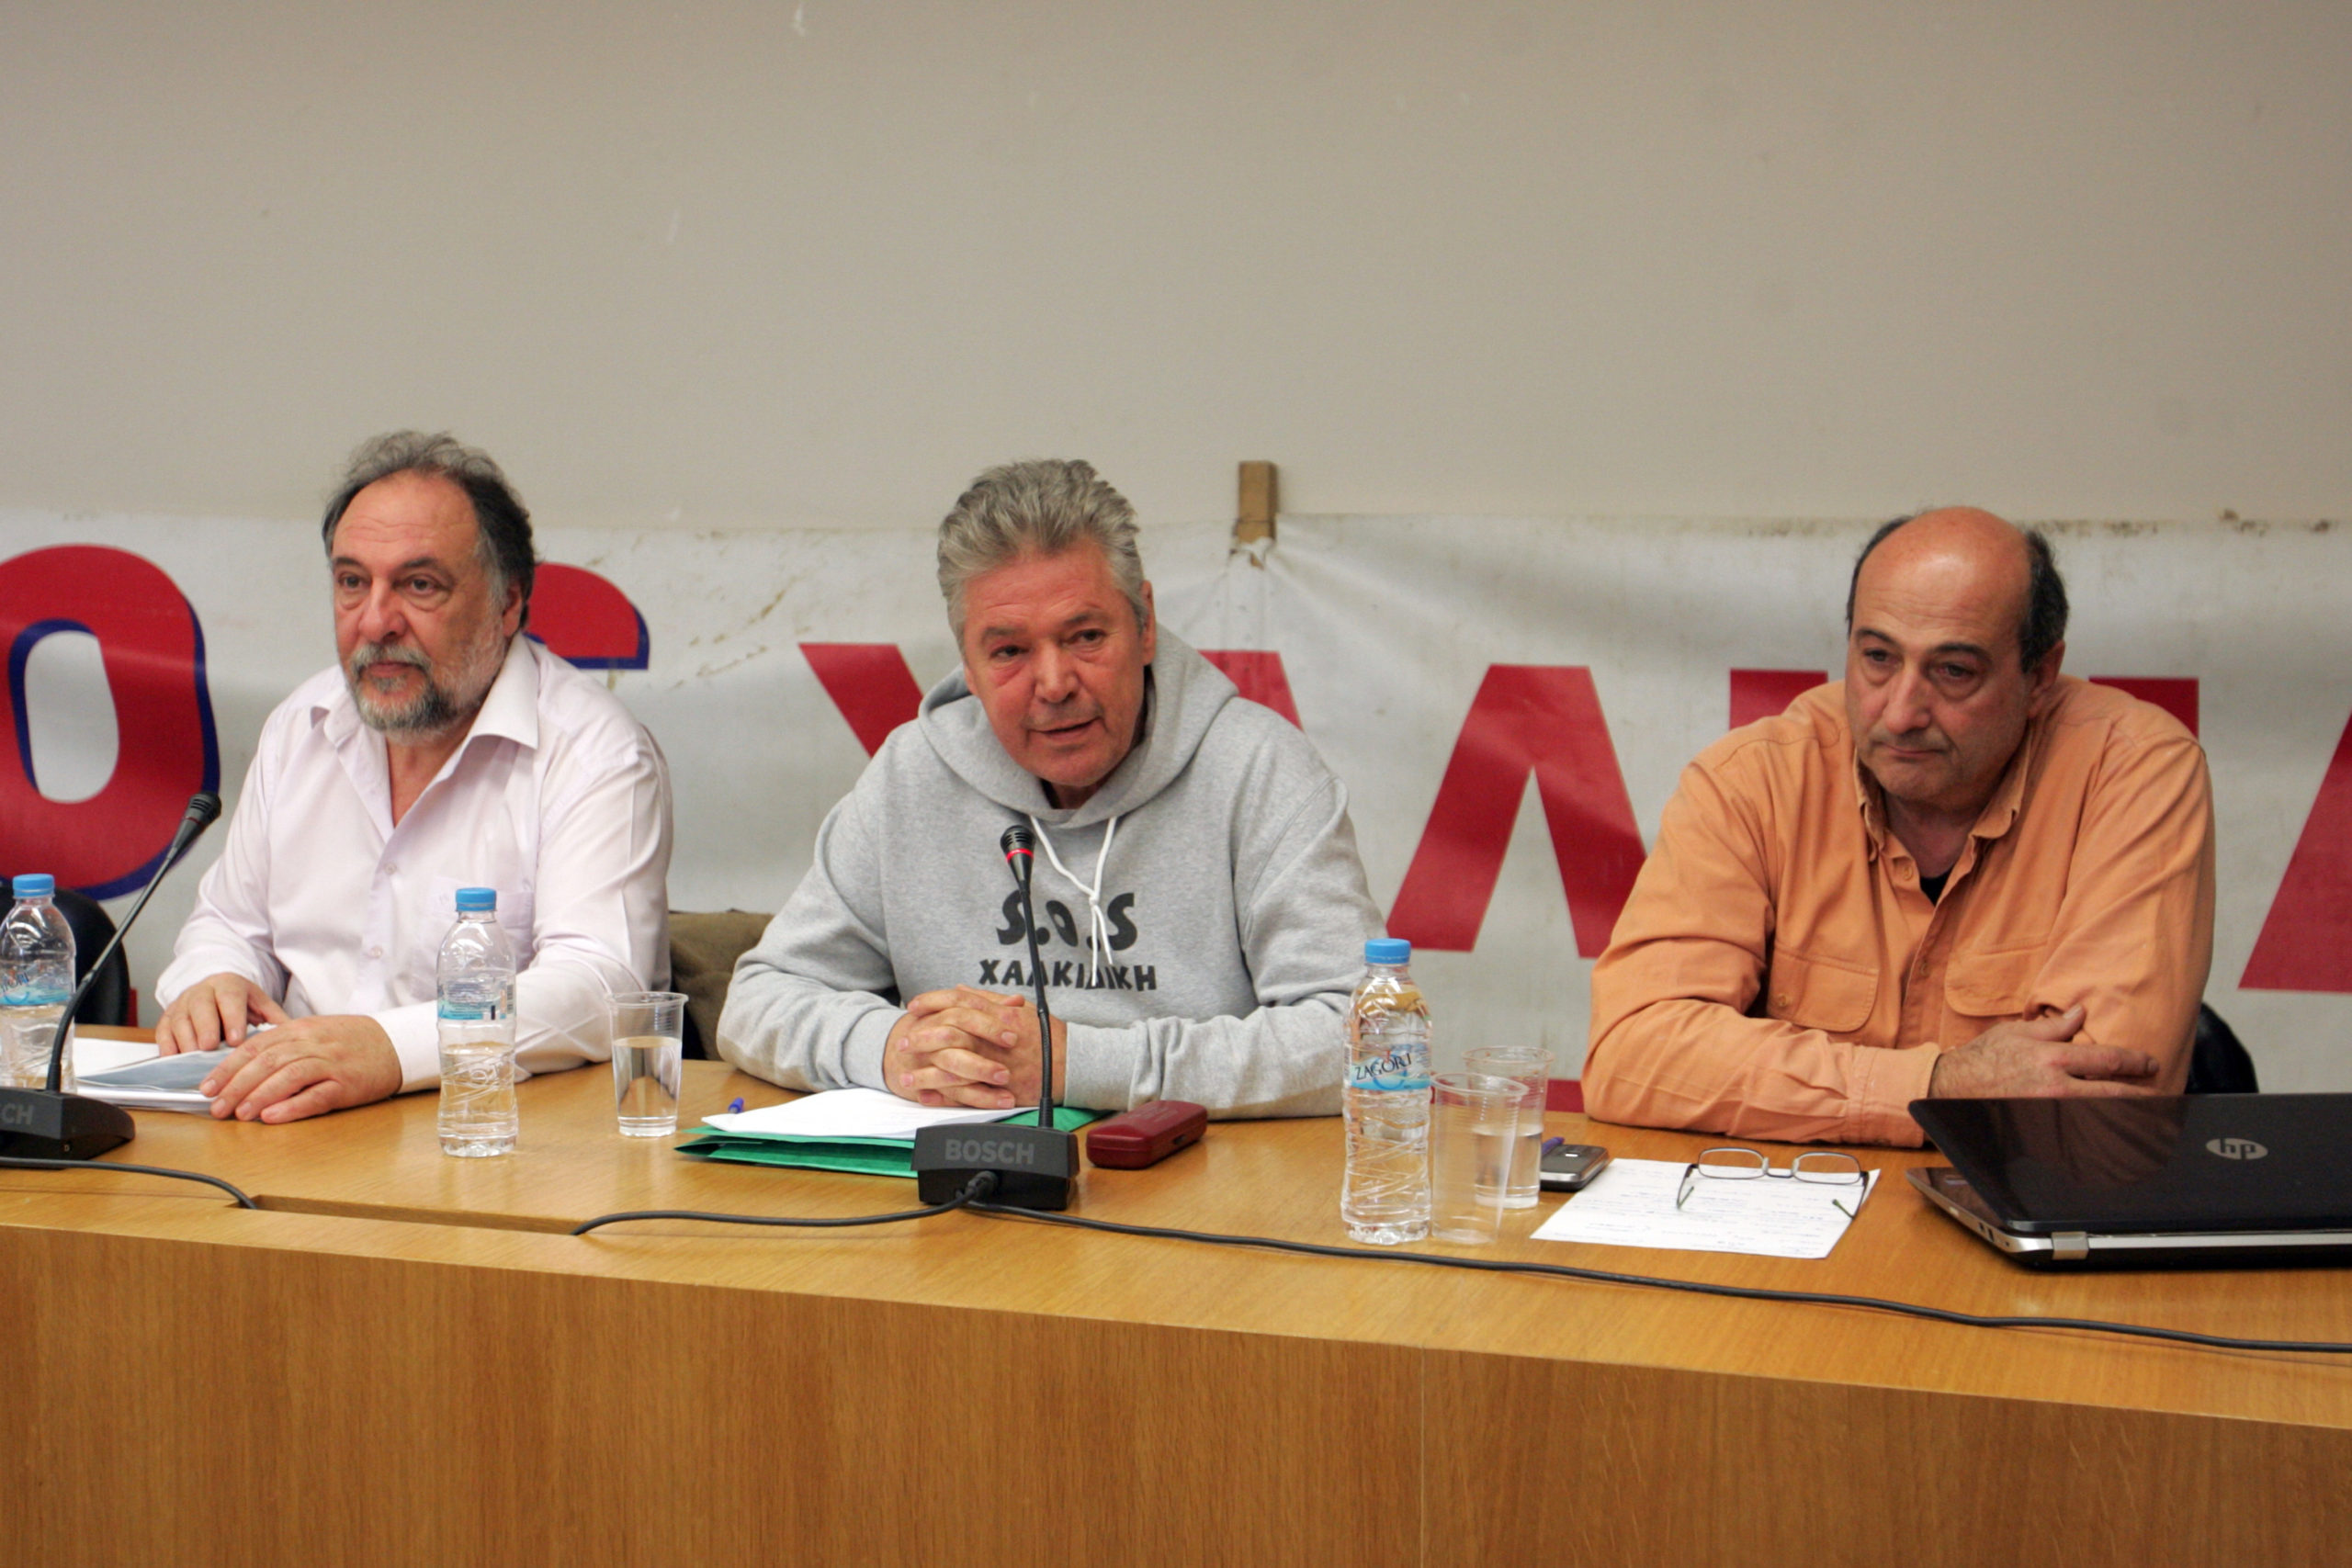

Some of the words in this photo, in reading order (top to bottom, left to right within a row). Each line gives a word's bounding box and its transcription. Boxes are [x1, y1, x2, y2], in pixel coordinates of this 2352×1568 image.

[1354, 1052, 1412, 1081] ZAGORI
[0, 1102, 34, 1125] CH
[944, 1138, 1035, 1165] BOSCH
